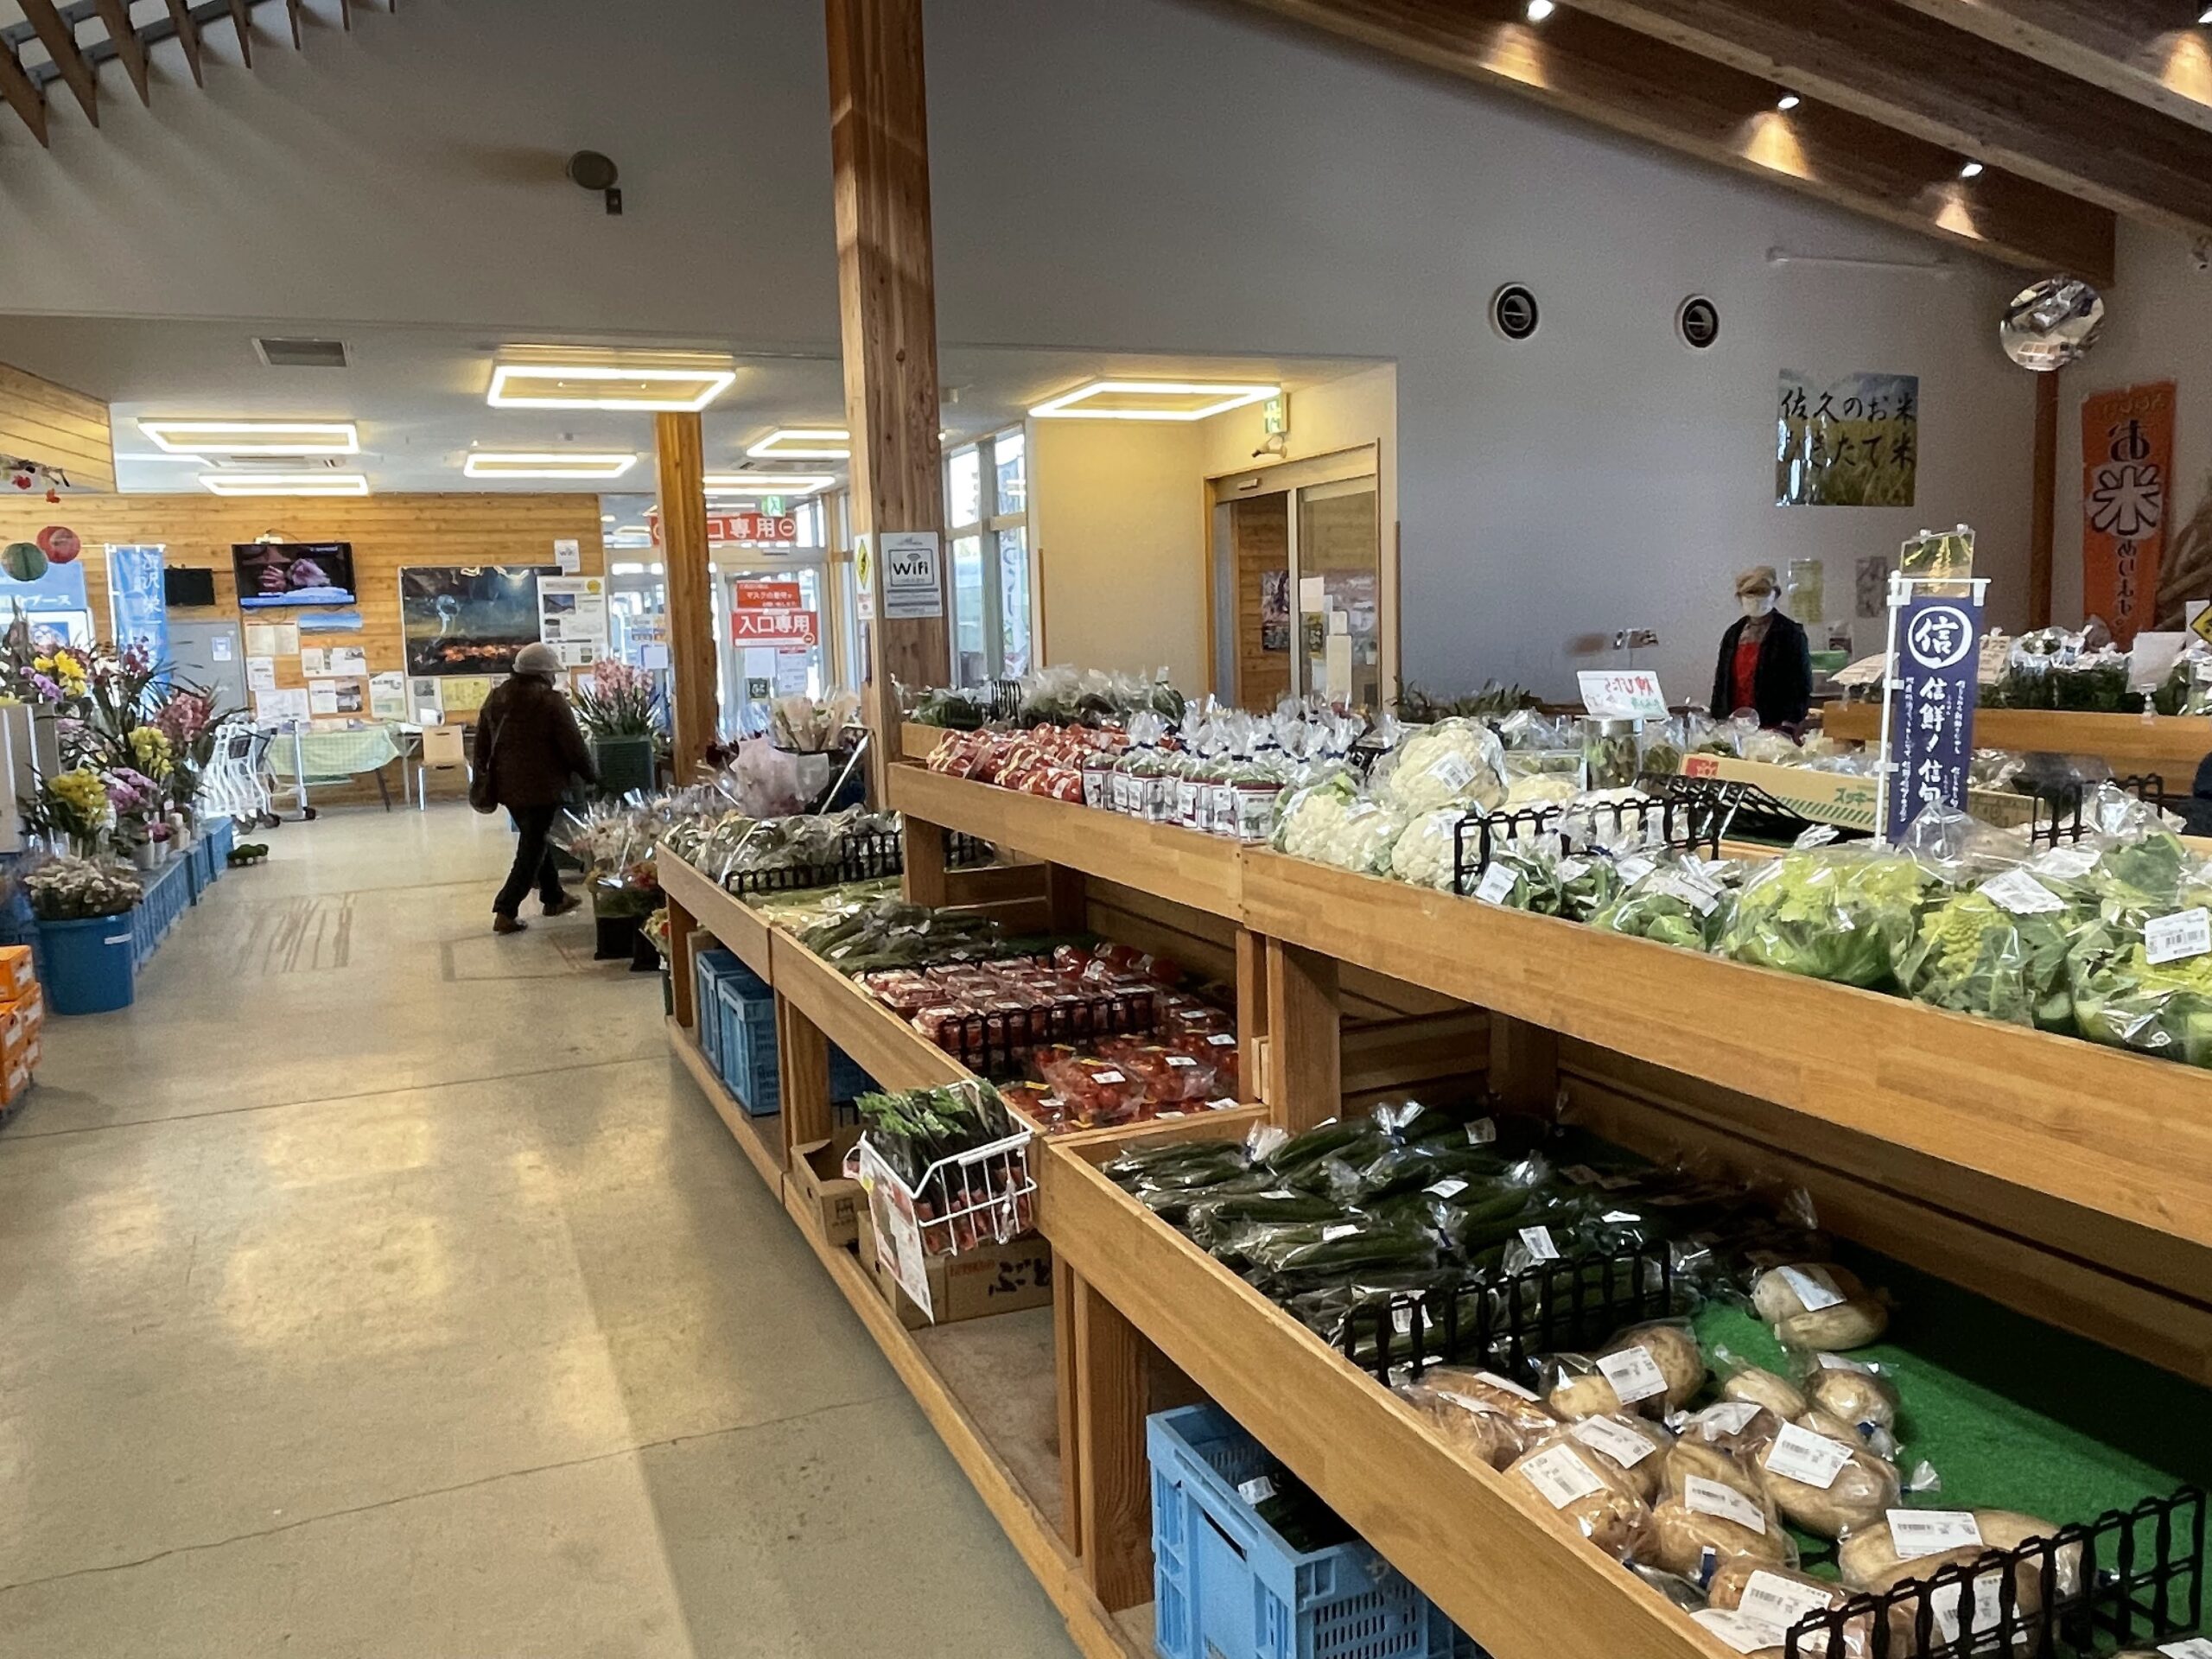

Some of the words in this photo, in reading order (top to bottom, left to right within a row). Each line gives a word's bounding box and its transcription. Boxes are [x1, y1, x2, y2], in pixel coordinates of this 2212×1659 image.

[1781, 386, 1917, 426] 佐久のお米
[707, 518, 776, 538] 口専用
[893, 561, 929, 575] Wifi
[739, 615, 810, 634] 入口専用
